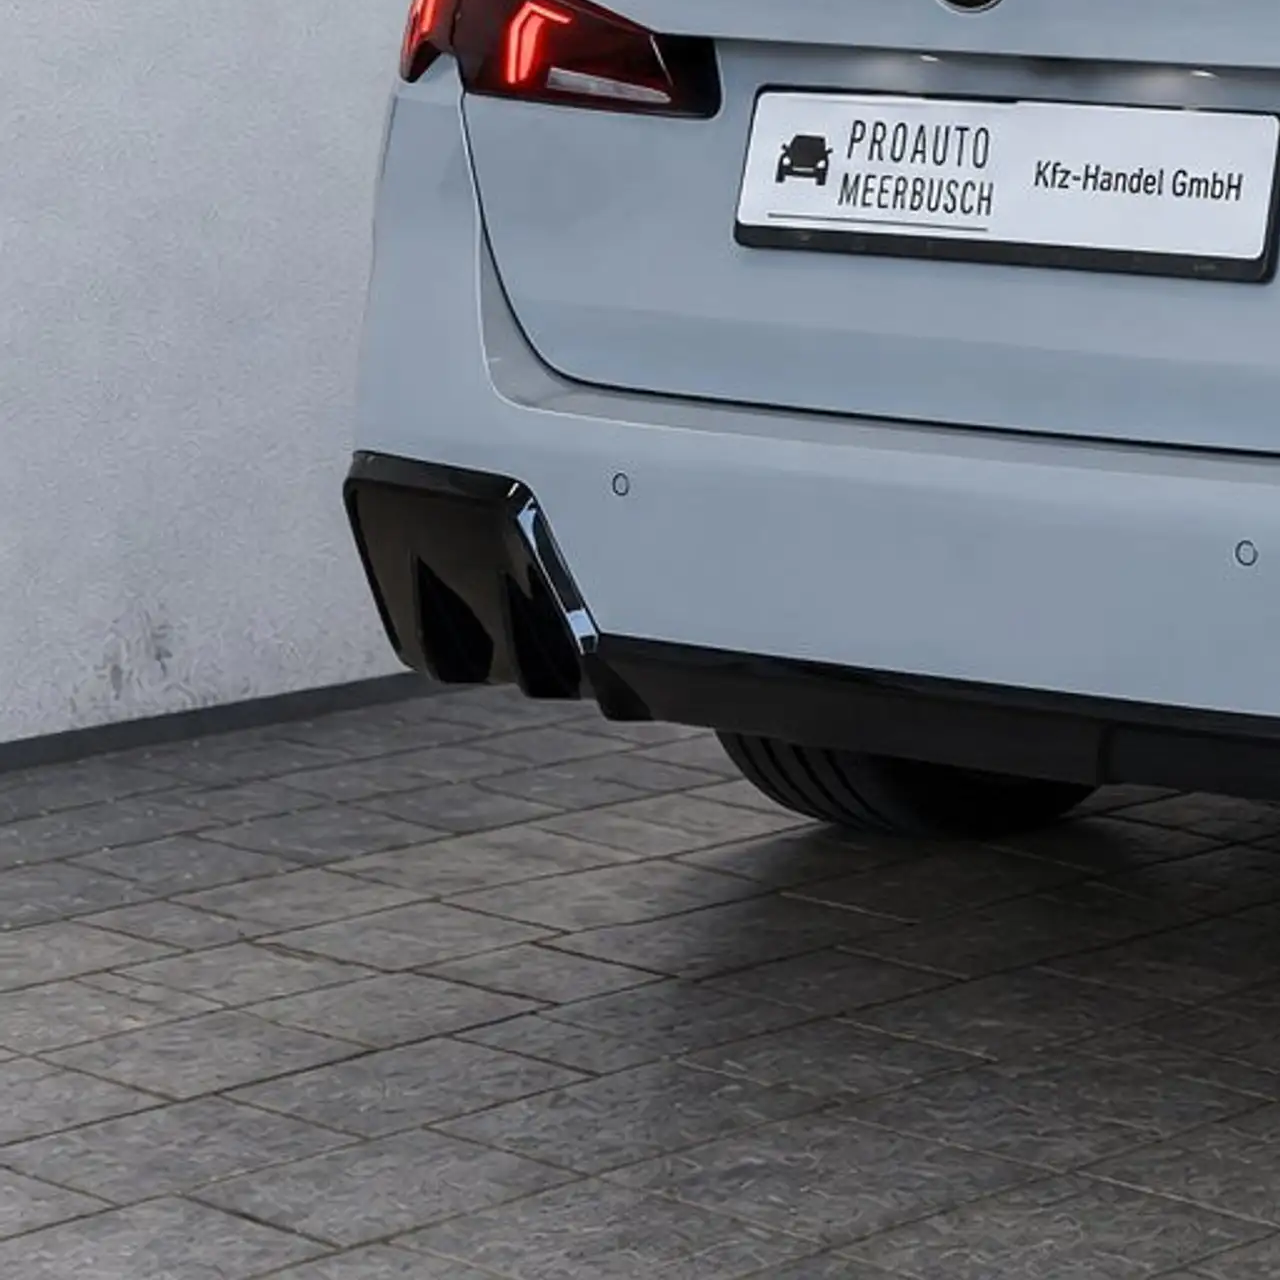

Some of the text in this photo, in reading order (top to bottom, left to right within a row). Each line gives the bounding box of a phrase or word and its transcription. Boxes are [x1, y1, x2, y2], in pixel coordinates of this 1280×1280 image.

[846, 119, 991, 169] PROAUTO
[837, 172, 995, 216] MEERBUSCH
[1034, 160, 1244, 202] Kfz-Handel GmbH
